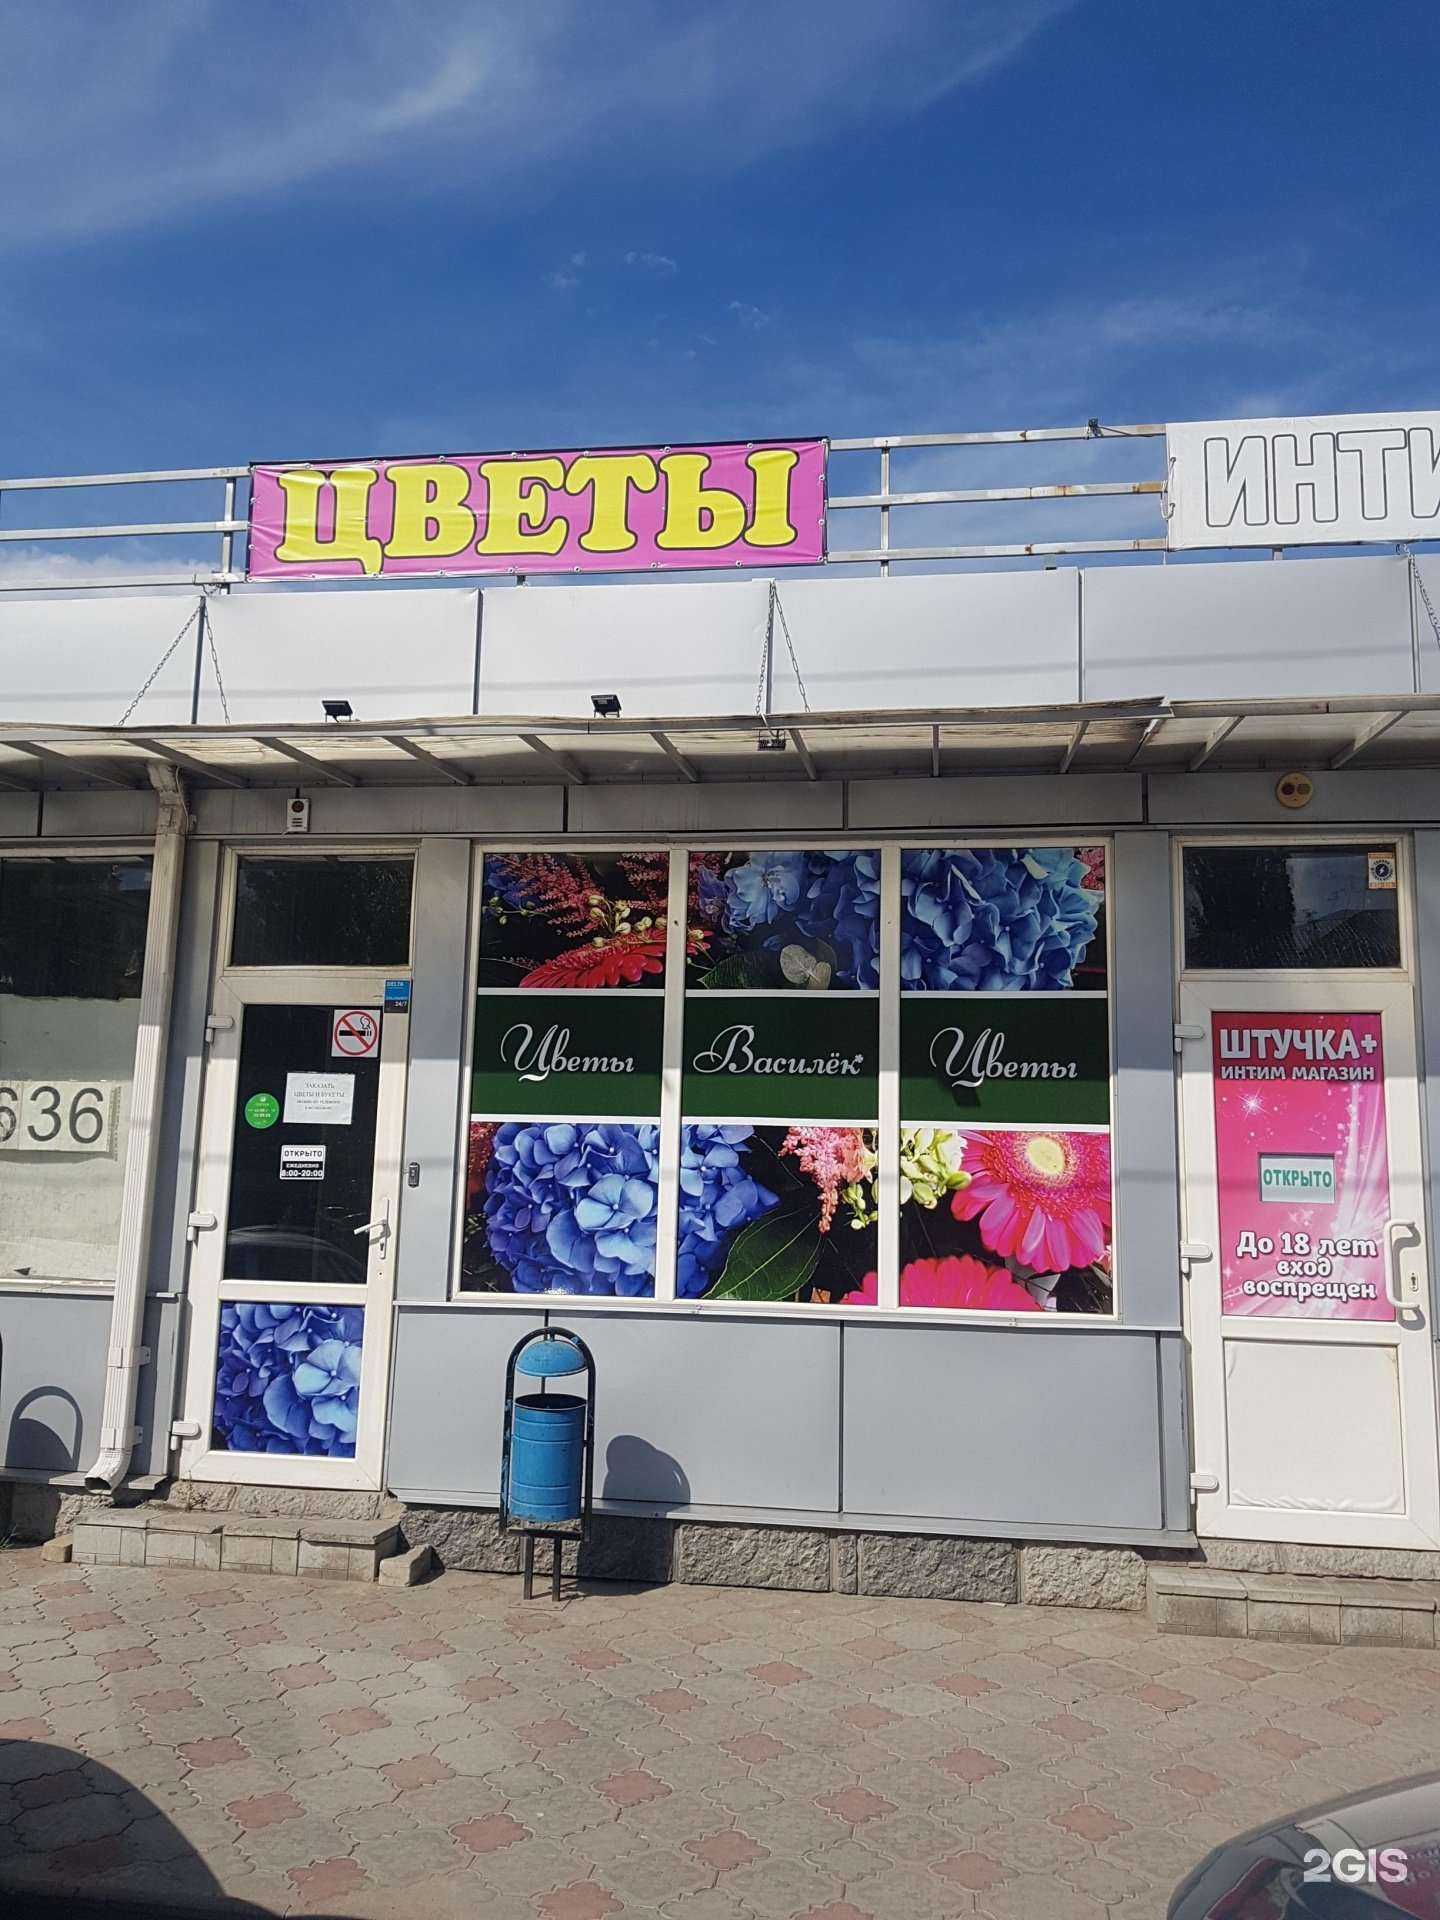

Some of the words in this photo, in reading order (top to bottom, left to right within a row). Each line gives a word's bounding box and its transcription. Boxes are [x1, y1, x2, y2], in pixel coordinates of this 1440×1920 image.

[273, 448, 799, 576] ЦВЕТЫ
[500, 1023, 634, 1082] Цветы
[693, 1024, 863, 1075] Василёк
[930, 1026, 1078, 1087] Цветы
[1221, 1066, 1286, 1080] ИНТИМ
[1292, 1066, 1375, 1081] МАГАЗИН
[281, 1169, 323, 1177] 8:00-20:00
[1263, 1168, 1333, 1188] ОТКРЫТО
[1236, 1231, 1274, 1258] До
[1281, 1232, 1311, 1255] 18
[1318, 1239, 1378, 1257] лет
[1276, 1257, 1333, 1276] вход
[1243, 1280, 1377, 1303] воспрещен
